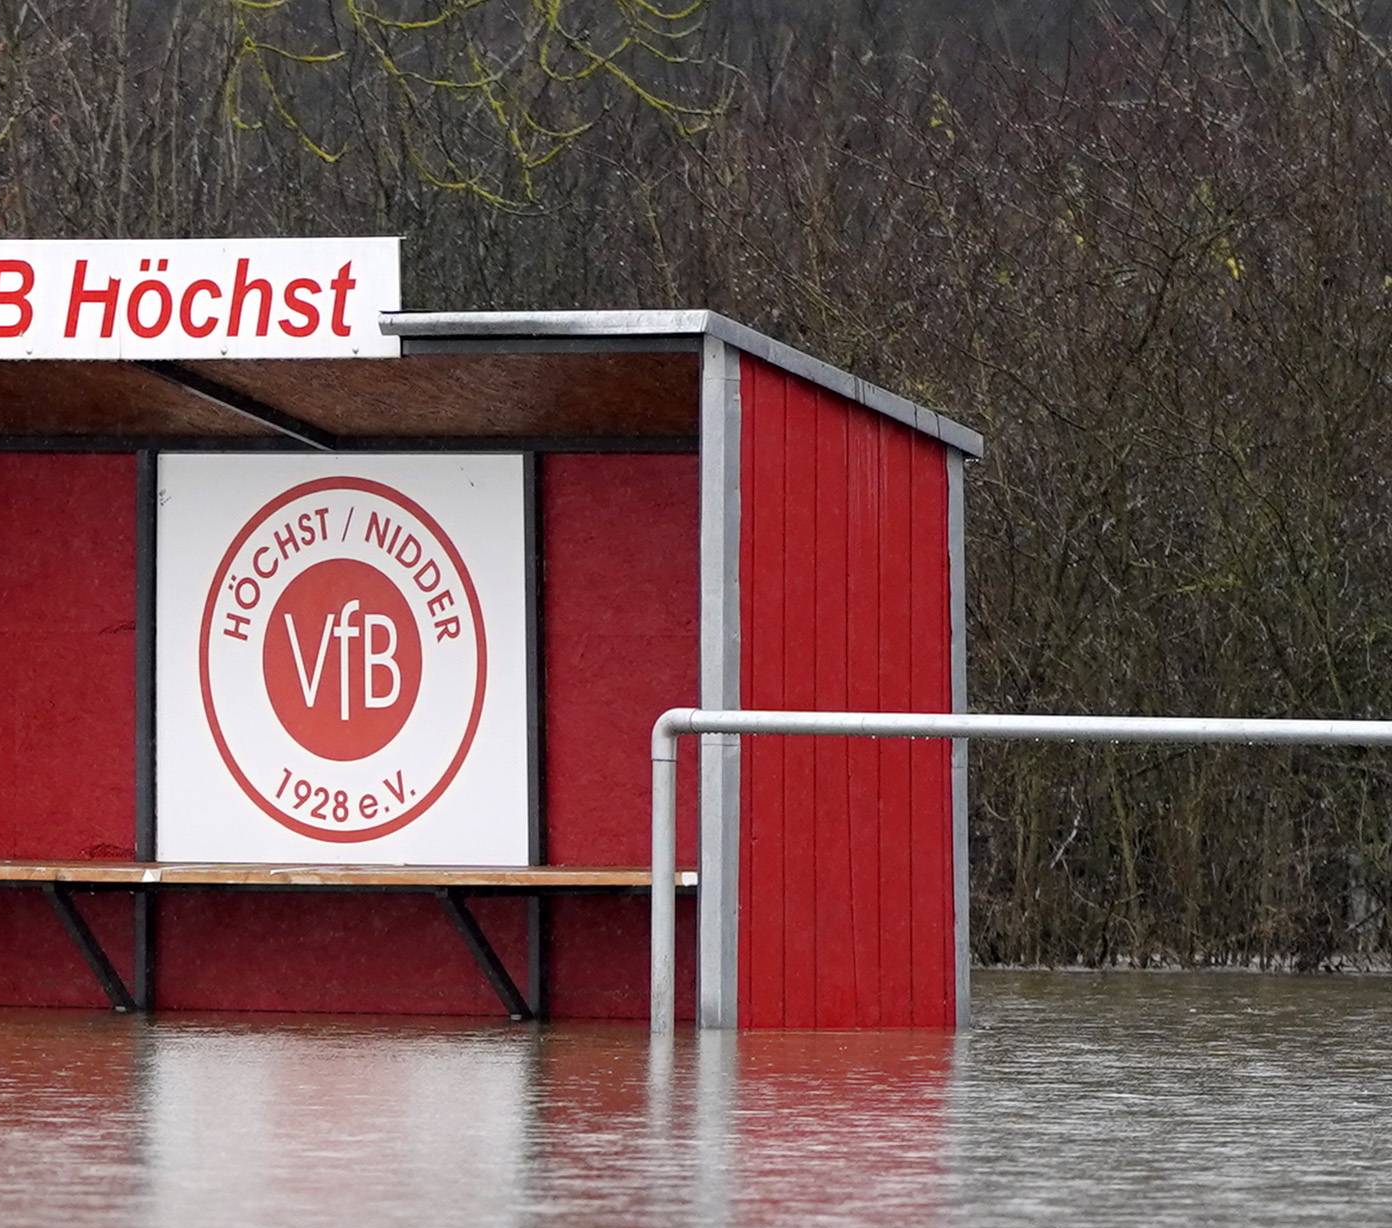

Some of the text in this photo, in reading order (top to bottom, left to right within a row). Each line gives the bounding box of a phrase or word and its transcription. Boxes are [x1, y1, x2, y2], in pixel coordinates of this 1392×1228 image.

[63, 257, 357, 338] Höchst
[223, 507, 330, 642] HÖCHST
[364, 511, 462, 645] NIDDER
[283, 598, 403, 721] VfB
[274, 767, 417, 823] 1928 e.V.
